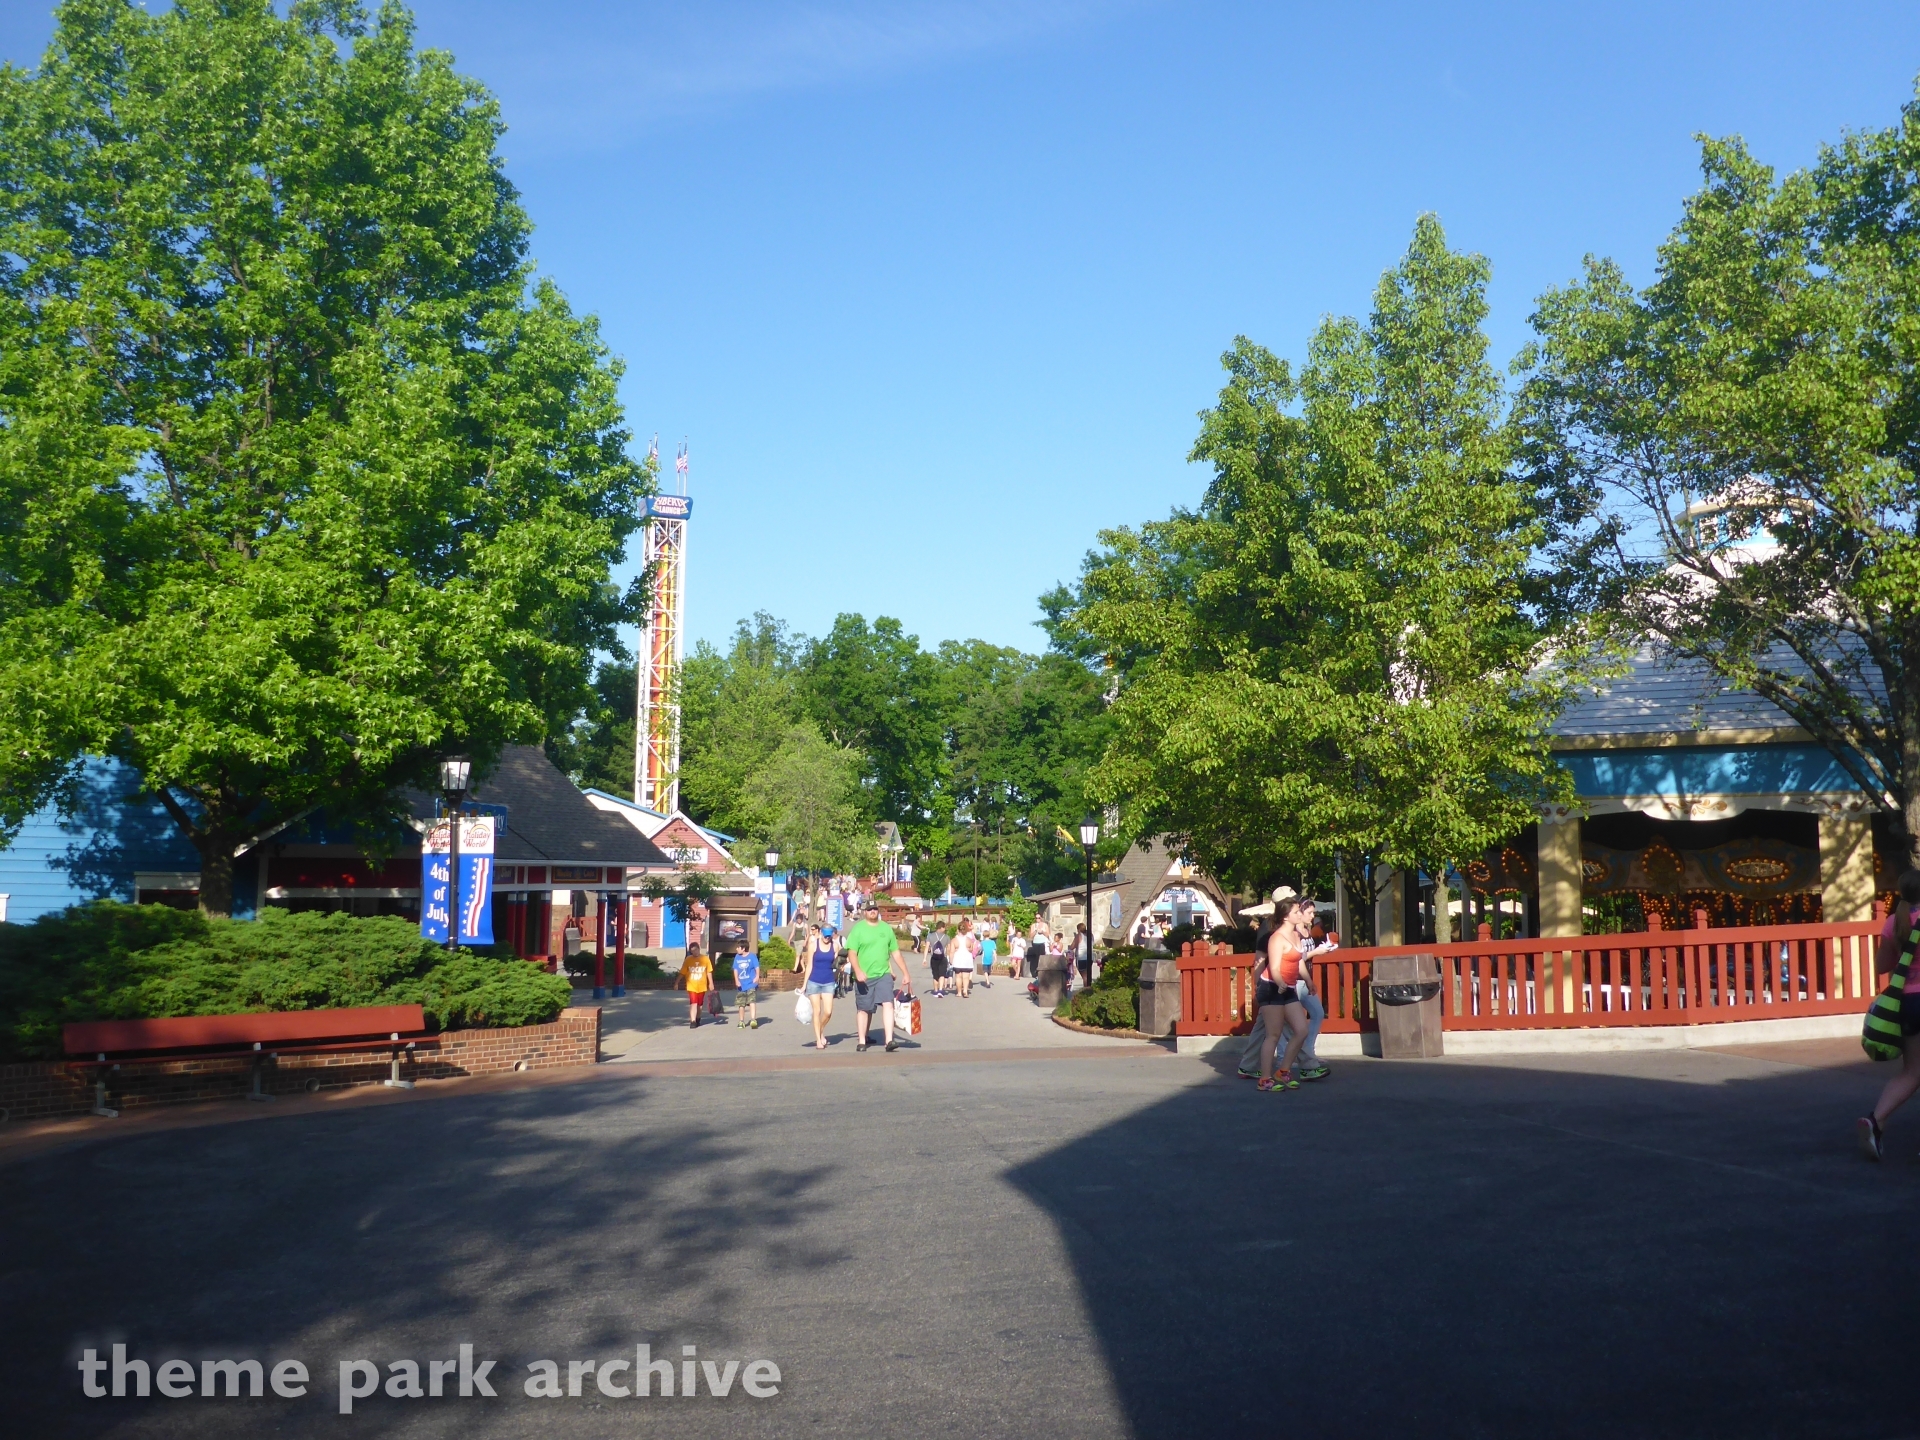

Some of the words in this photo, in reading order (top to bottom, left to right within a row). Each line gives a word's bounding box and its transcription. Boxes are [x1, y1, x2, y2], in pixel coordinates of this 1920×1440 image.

[656, 496, 689, 508] LIBERTY
[659, 505, 681, 515] LAUNCH
[463, 829, 491, 840] Holiday
[463, 839, 488, 848] World
[430, 862, 450, 882] 4th
[433, 886, 447, 901] of
[426, 903, 450, 929] July
